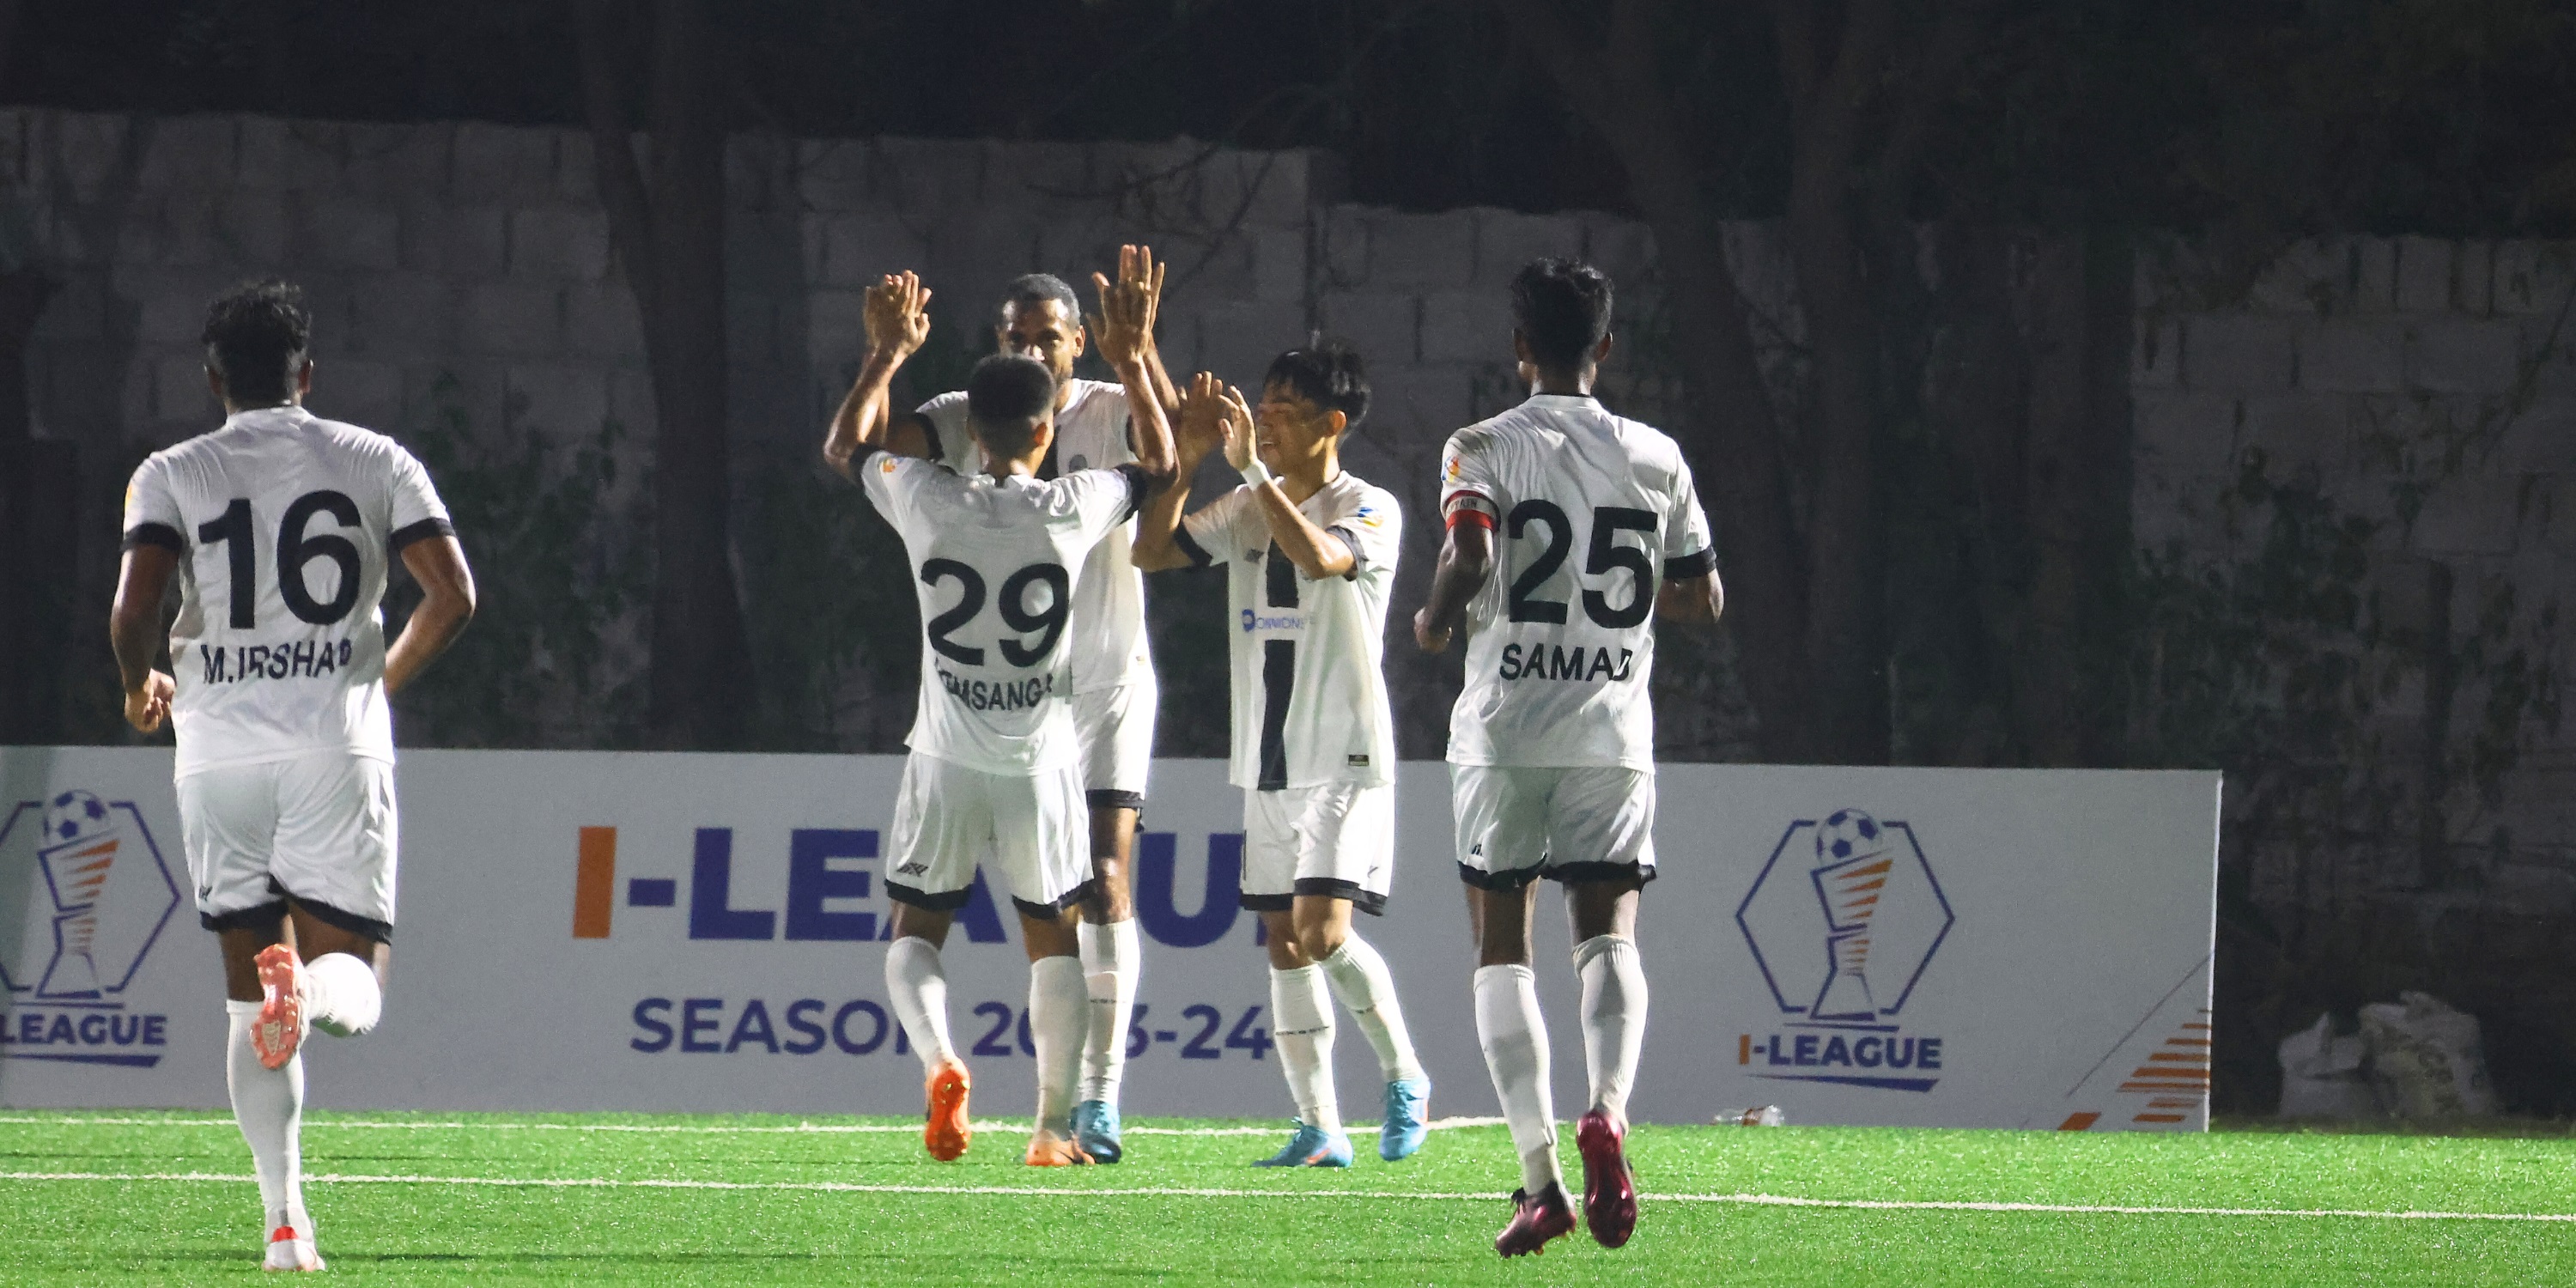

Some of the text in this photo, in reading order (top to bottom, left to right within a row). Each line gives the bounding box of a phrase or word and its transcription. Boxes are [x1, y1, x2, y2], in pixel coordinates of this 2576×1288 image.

[198, 489, 361, 629] 16
[1508, 499, 1658, 629] 25
[920, 557, 1070, 668] 29
[200, 638, 352, 684] M.IRSHAD
[1499, 642, 1633, 682] SAMAD
[573, 825, 1268, 948] I-LEU
[630, 997, 1274, 1060] SEASO 23-24
[1738, 1033, 1943, 1070] I-LEAGUE
